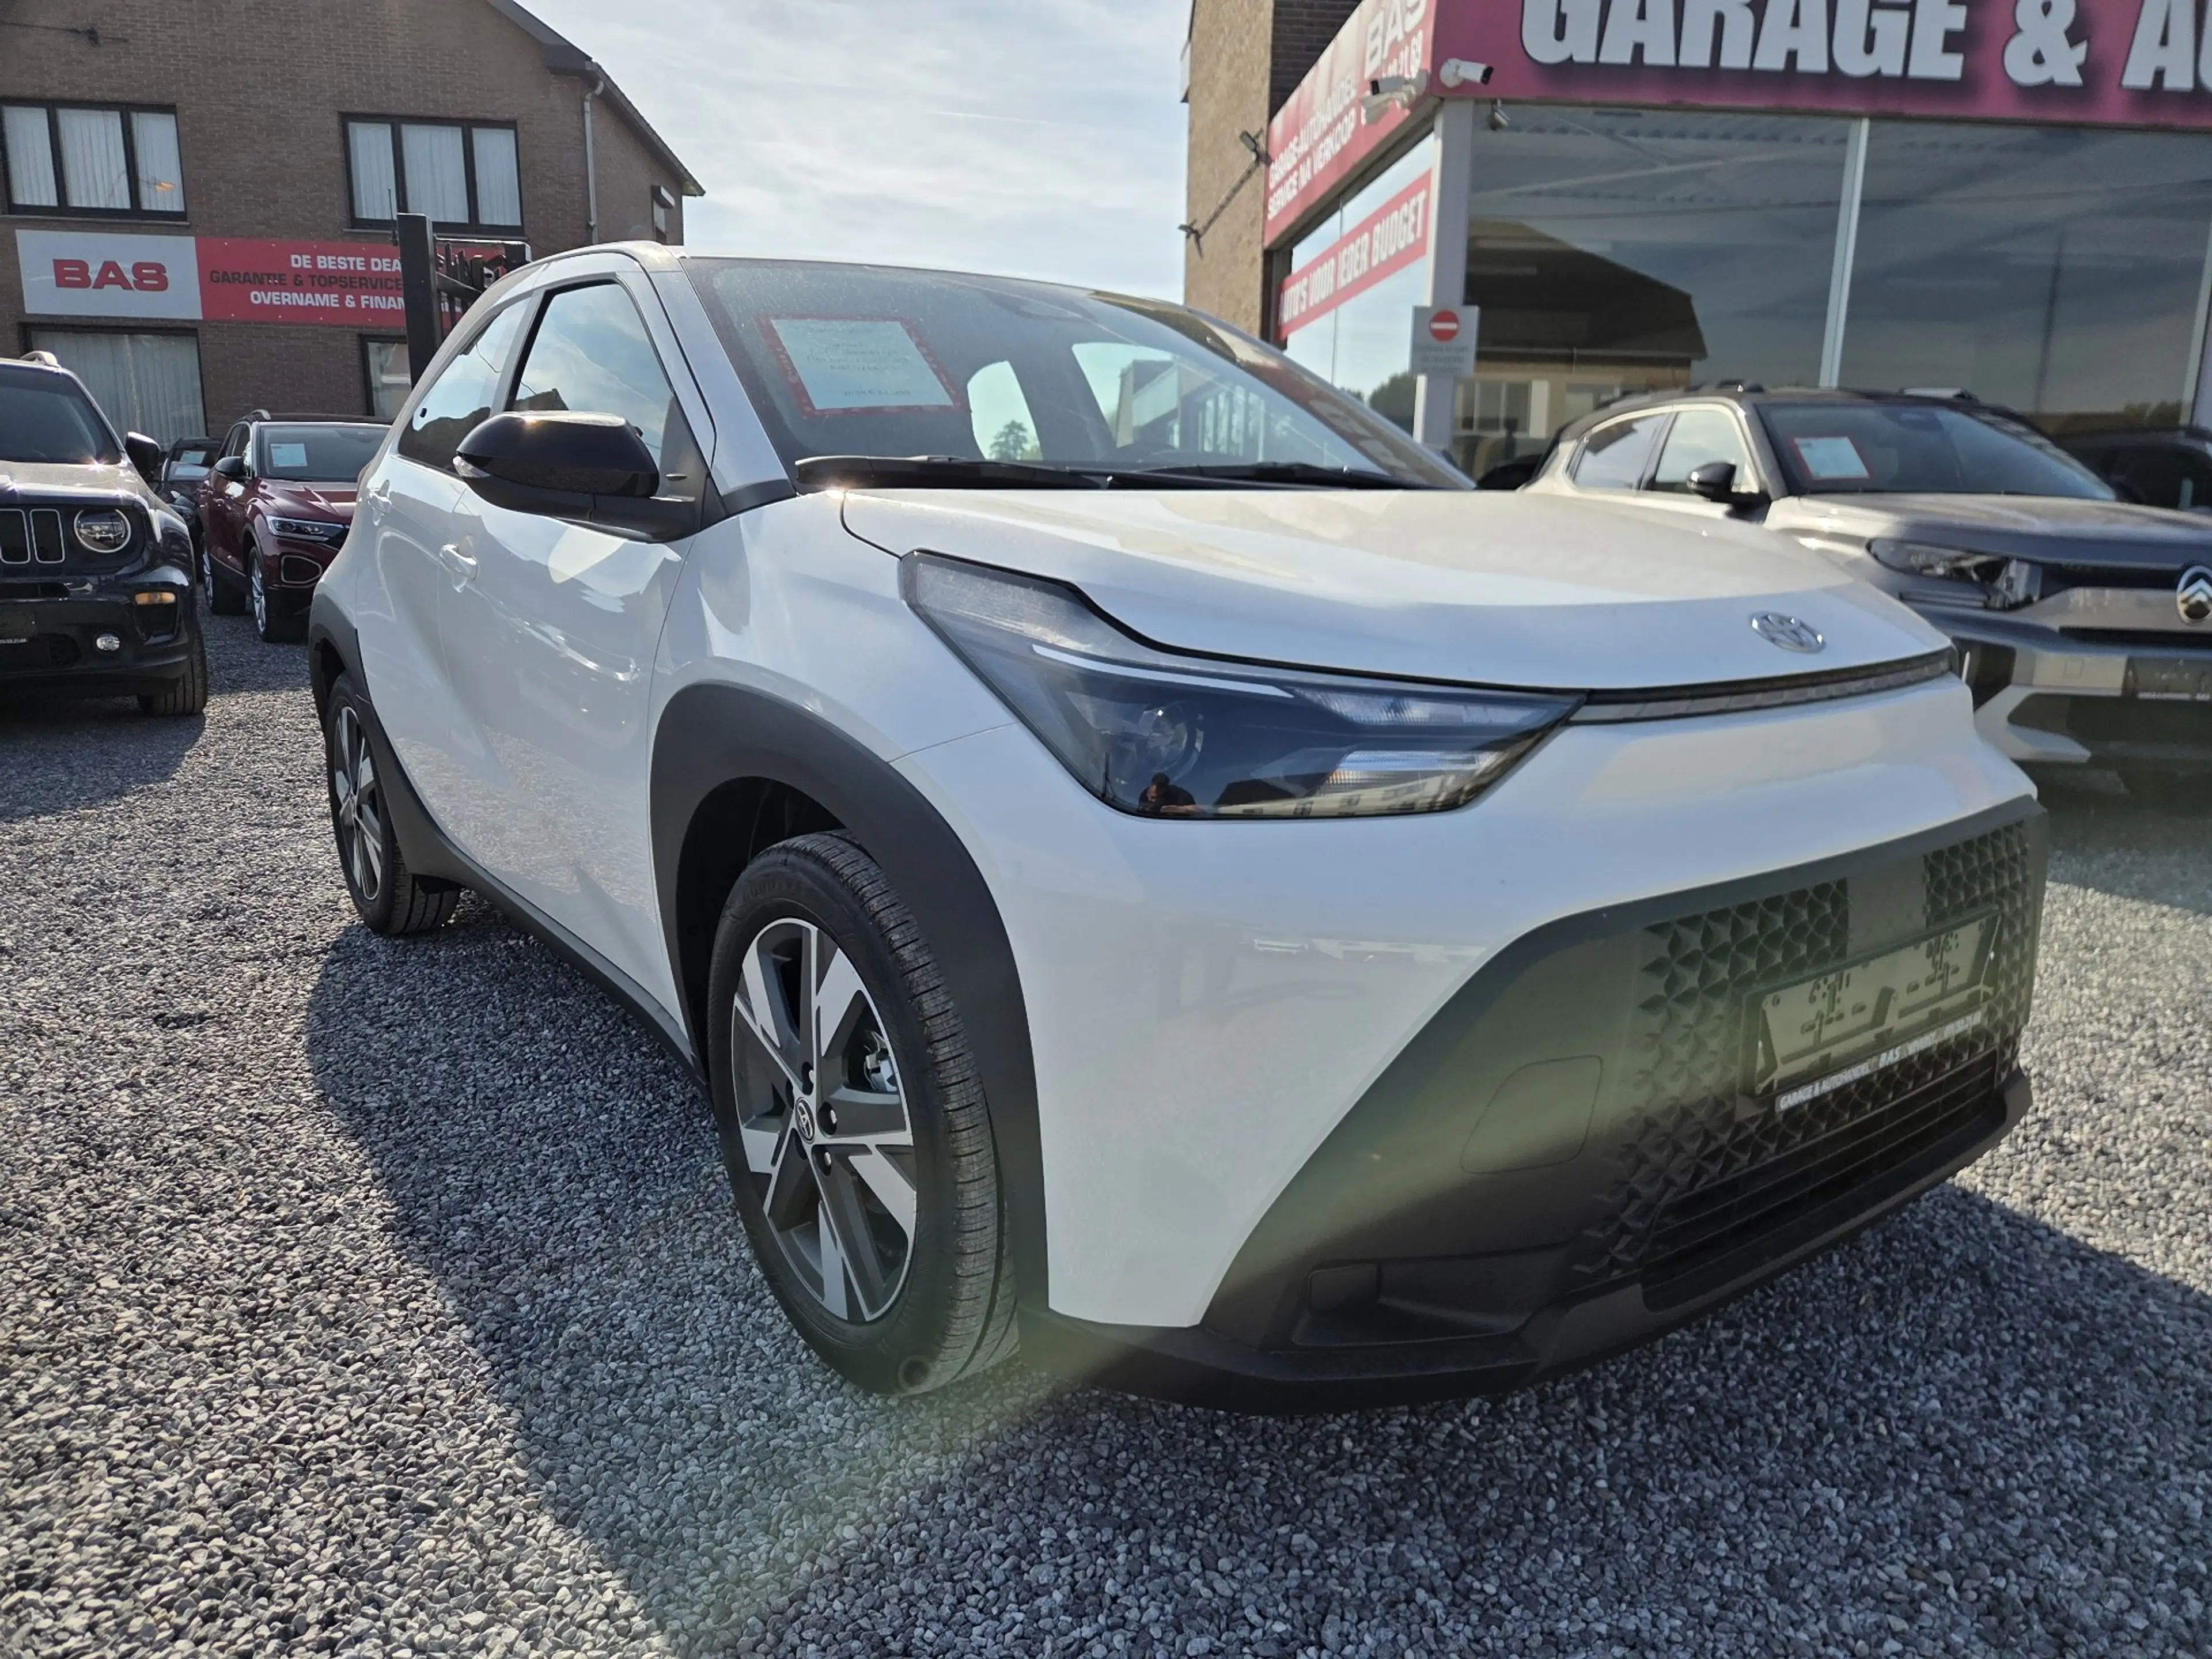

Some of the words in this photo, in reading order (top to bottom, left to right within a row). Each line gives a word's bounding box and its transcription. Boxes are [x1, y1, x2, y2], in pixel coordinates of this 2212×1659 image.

[1520, 0, 1966, 80] GARAGE
[2002, 0, 2088, 86] &
[2121, 0, 2212, 91] A
[1268, 169, 1298, 221] SERVICE
[1298, 156, 1312, 191] NA
[1313, 107, 1357, 176] VERKOOP
[1309, 256, 1335, 307] VOOR
[1337, 232, 1369, 290] IEDER
[1371, 188, 1427, 267] BUDGET
[52, 259, 169, 291] BAS
[291, 255, 312, 268] DE
[317, 255, 366, 270] BESTE
[370, 257, 402, 272] DEA
[210, 270, 287, 285] GARANTIE
[294, 274, 304, 286] &
[308, 274, 403, 291] TOPSERVICE
[250, 290, 340, 308] OVERNAME
[345, 295, 356, 308] &
[1879, 1045, 1902, 1069] BAS
